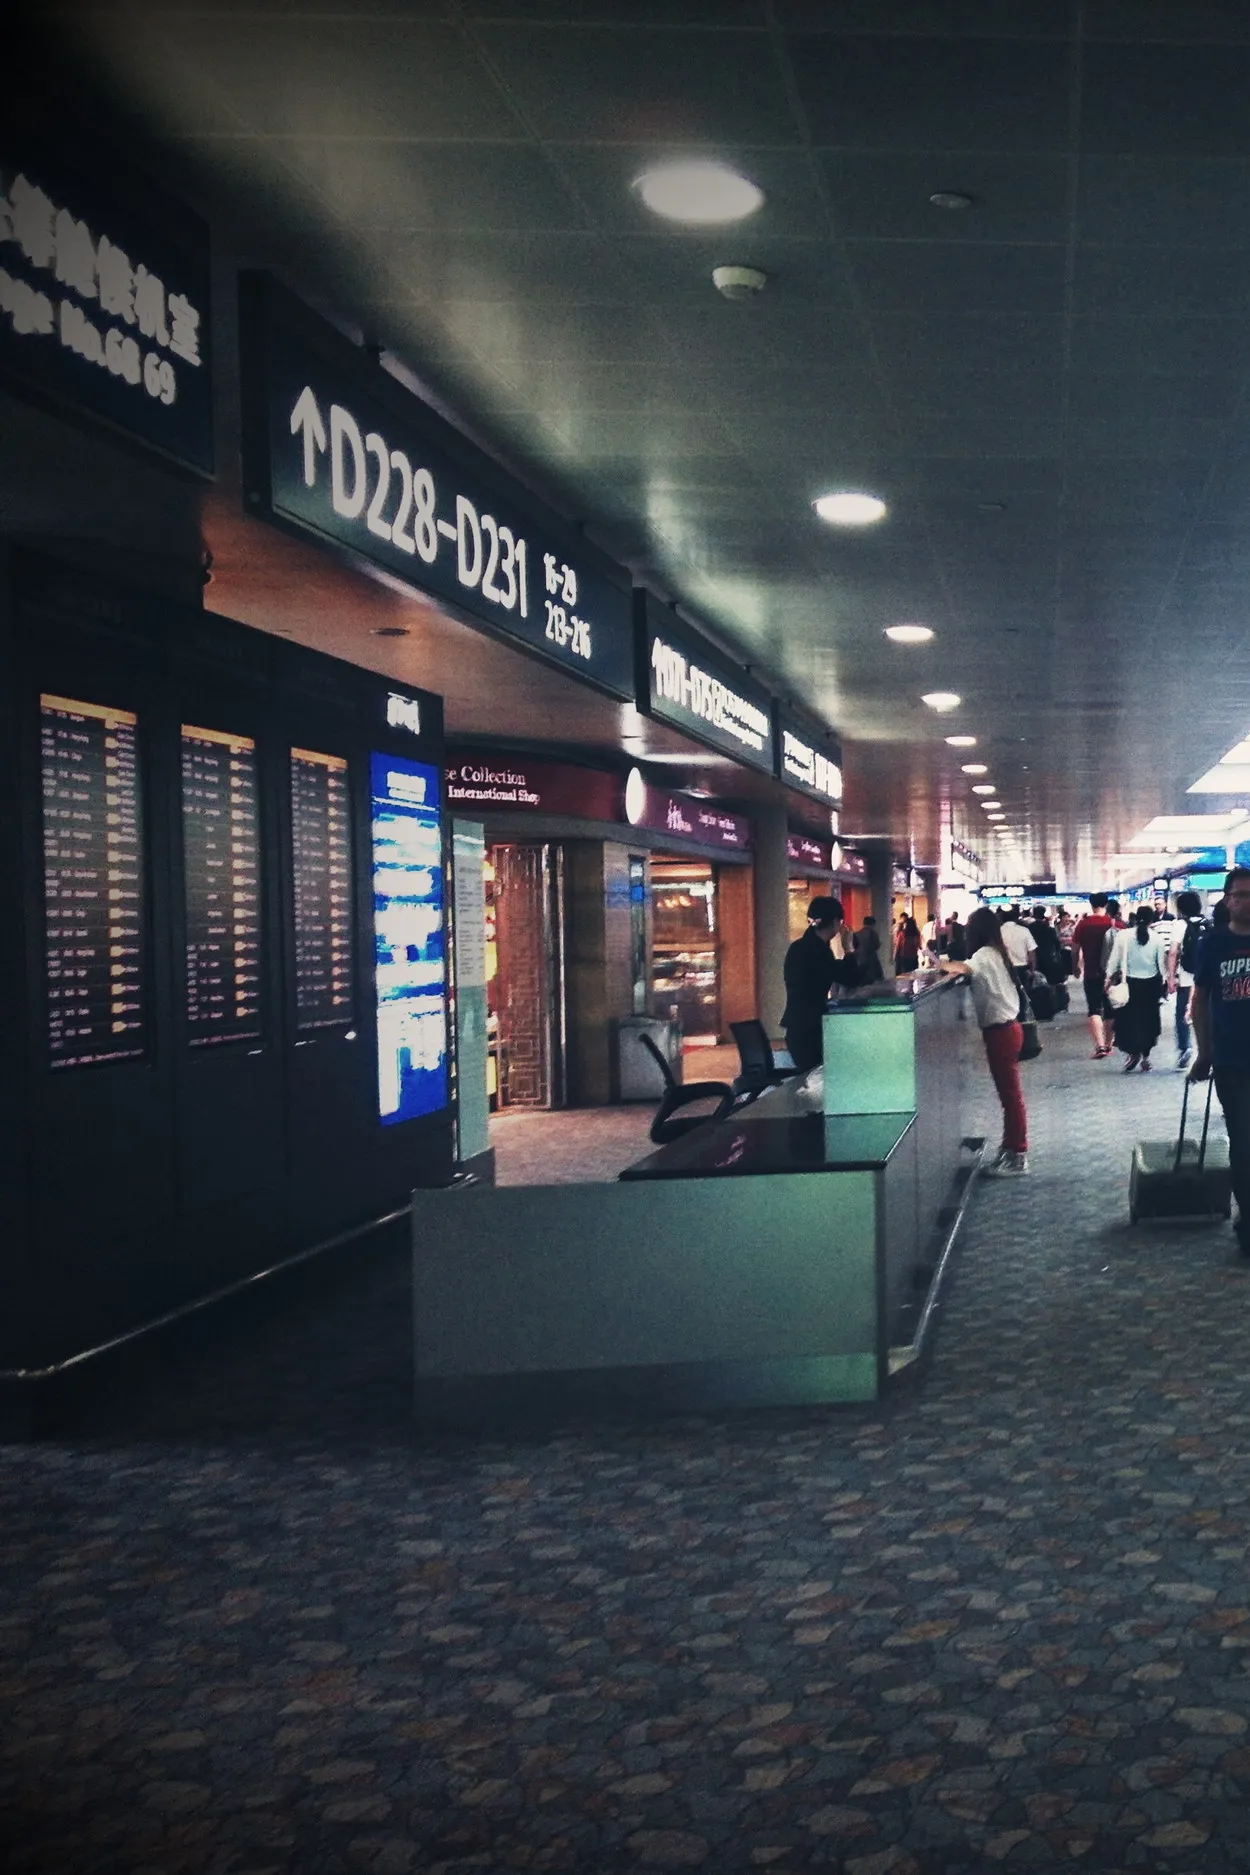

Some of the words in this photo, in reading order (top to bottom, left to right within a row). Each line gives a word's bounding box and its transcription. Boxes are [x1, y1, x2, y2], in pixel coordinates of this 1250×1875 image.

[330, 403, 528, 618] D228-D231
[460, 765, 526, 786] Collection
[448, 785, 517, 801] International
[518, 789, 540, 805] Shop
